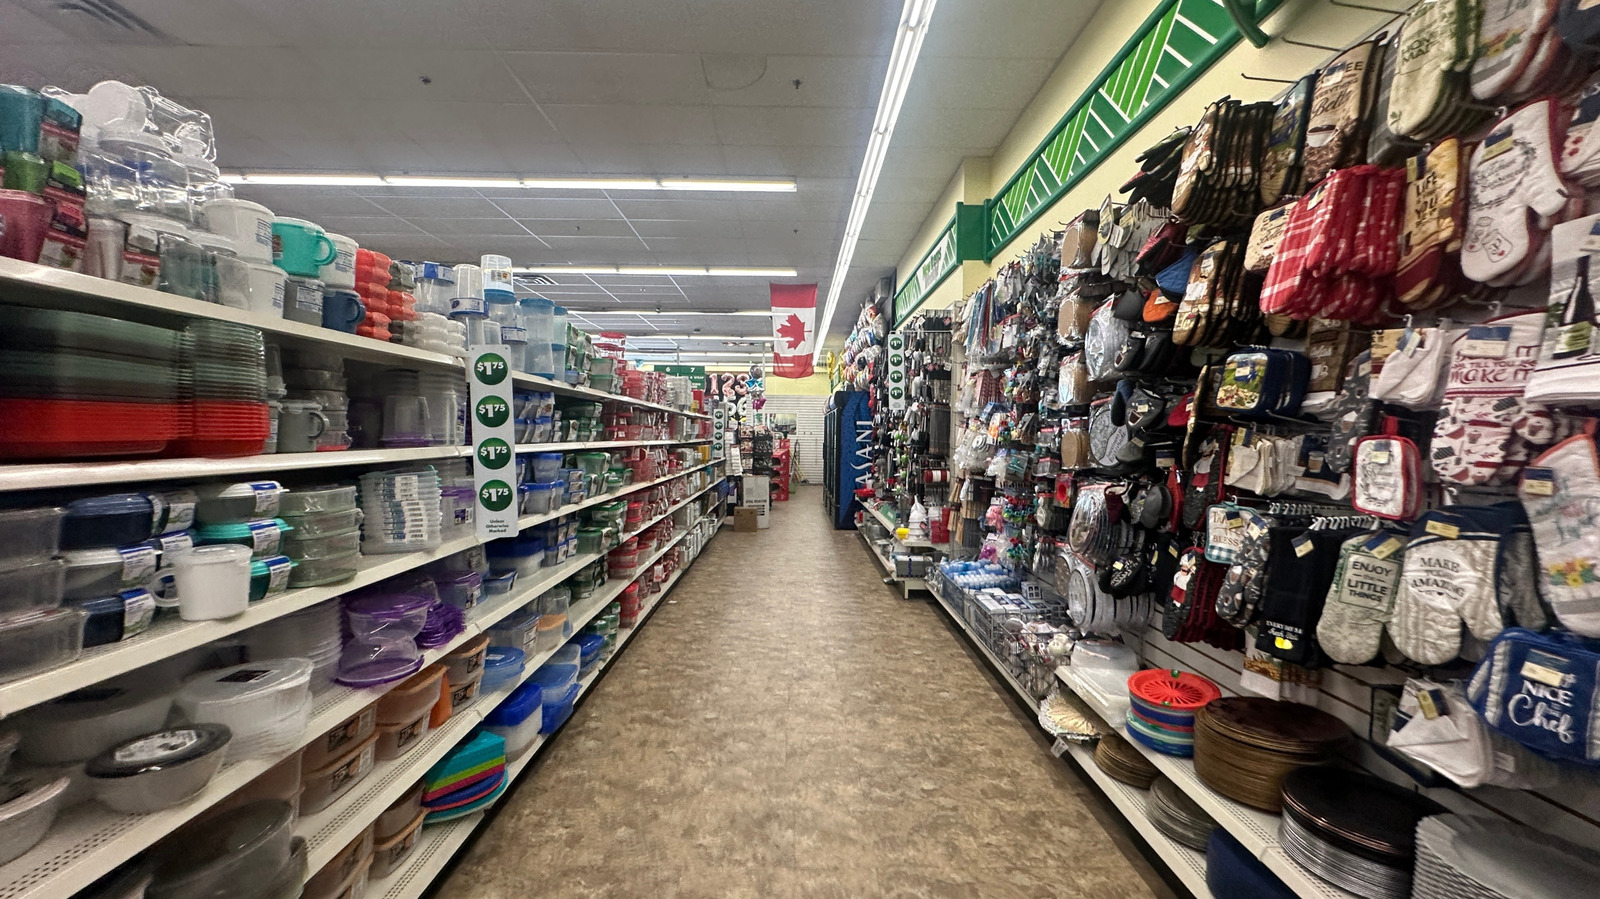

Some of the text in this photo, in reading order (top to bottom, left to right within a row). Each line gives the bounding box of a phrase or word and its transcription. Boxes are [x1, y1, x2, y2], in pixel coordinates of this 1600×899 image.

[850, 420, 874, 484] ASANI
[1352, 561, 1392, 577] ENJOY
[1420, 557, 1461, 573] MAKE
[1347, 579, 1388, 596] LITTLE
[1349, 589, 1384, 603] THINGS
[1411, 578, 1465, 598] AMAZING
[1522, 679, 1574, 707] NICE
[1508, 693, 1576, 744] Chef
